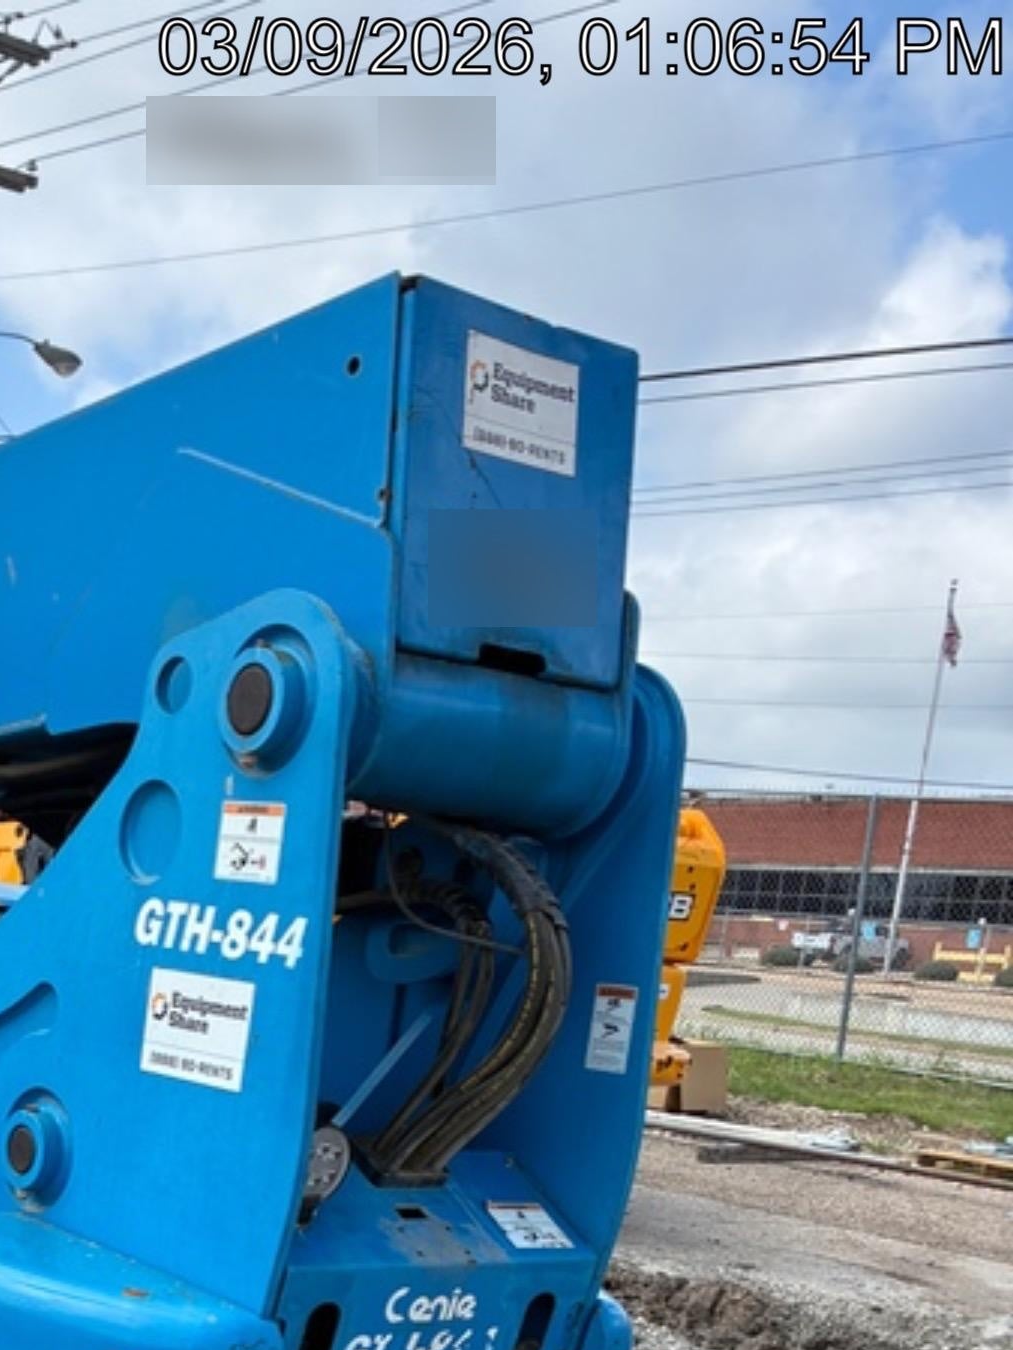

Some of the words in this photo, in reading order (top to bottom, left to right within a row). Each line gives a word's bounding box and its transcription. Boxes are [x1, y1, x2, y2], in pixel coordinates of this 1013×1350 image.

[492, 361, 575, 403] Equipment
[491, 383, 536, 414] Share
[134, 897, 309, 971] GTH-844
[171, 990, 248, 1020] Equipment
[169, 1010, 208, 1035] Share
